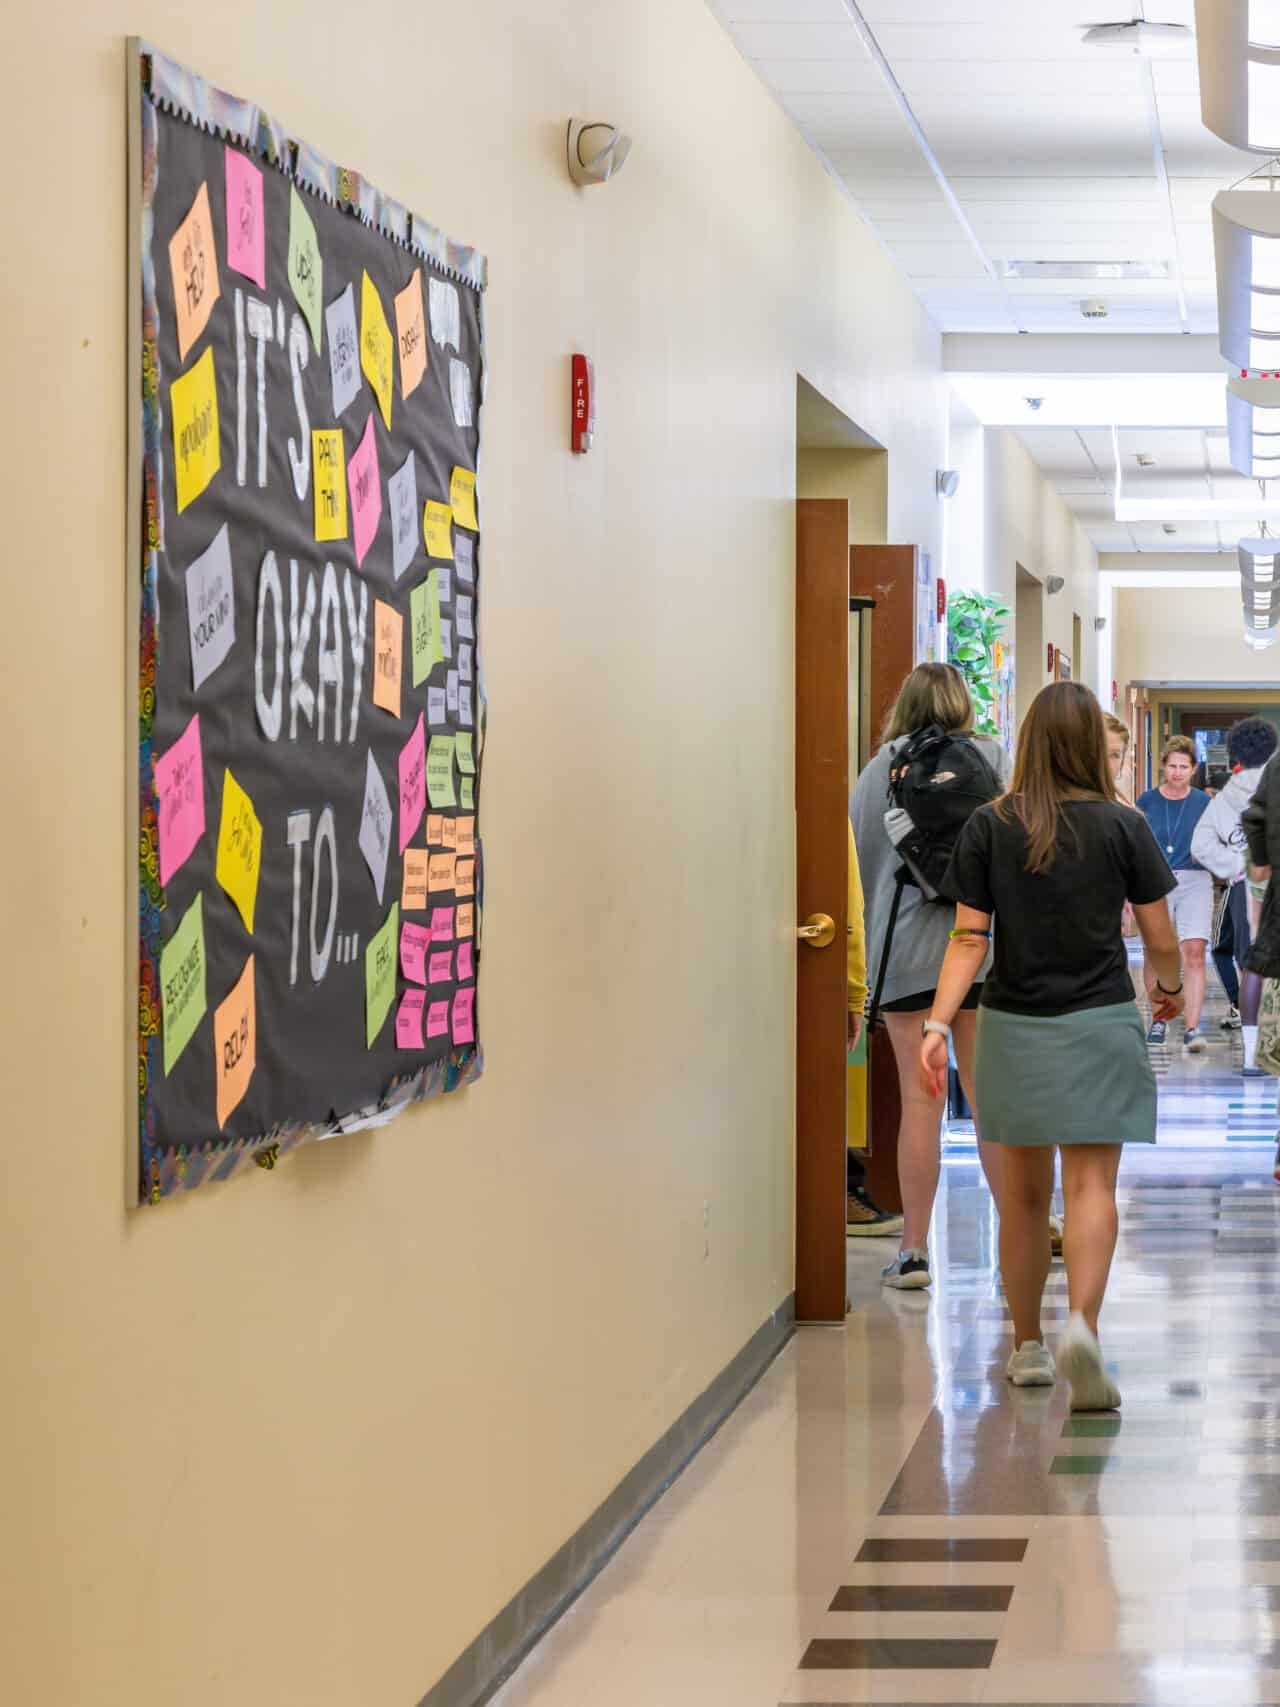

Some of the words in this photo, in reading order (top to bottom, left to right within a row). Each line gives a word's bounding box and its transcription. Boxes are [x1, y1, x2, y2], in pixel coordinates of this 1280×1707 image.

[234, 287, 310, 501] IT'S
[576, 378, 585, 419] FIRE
[254, 549, 369, 744] OKAY
